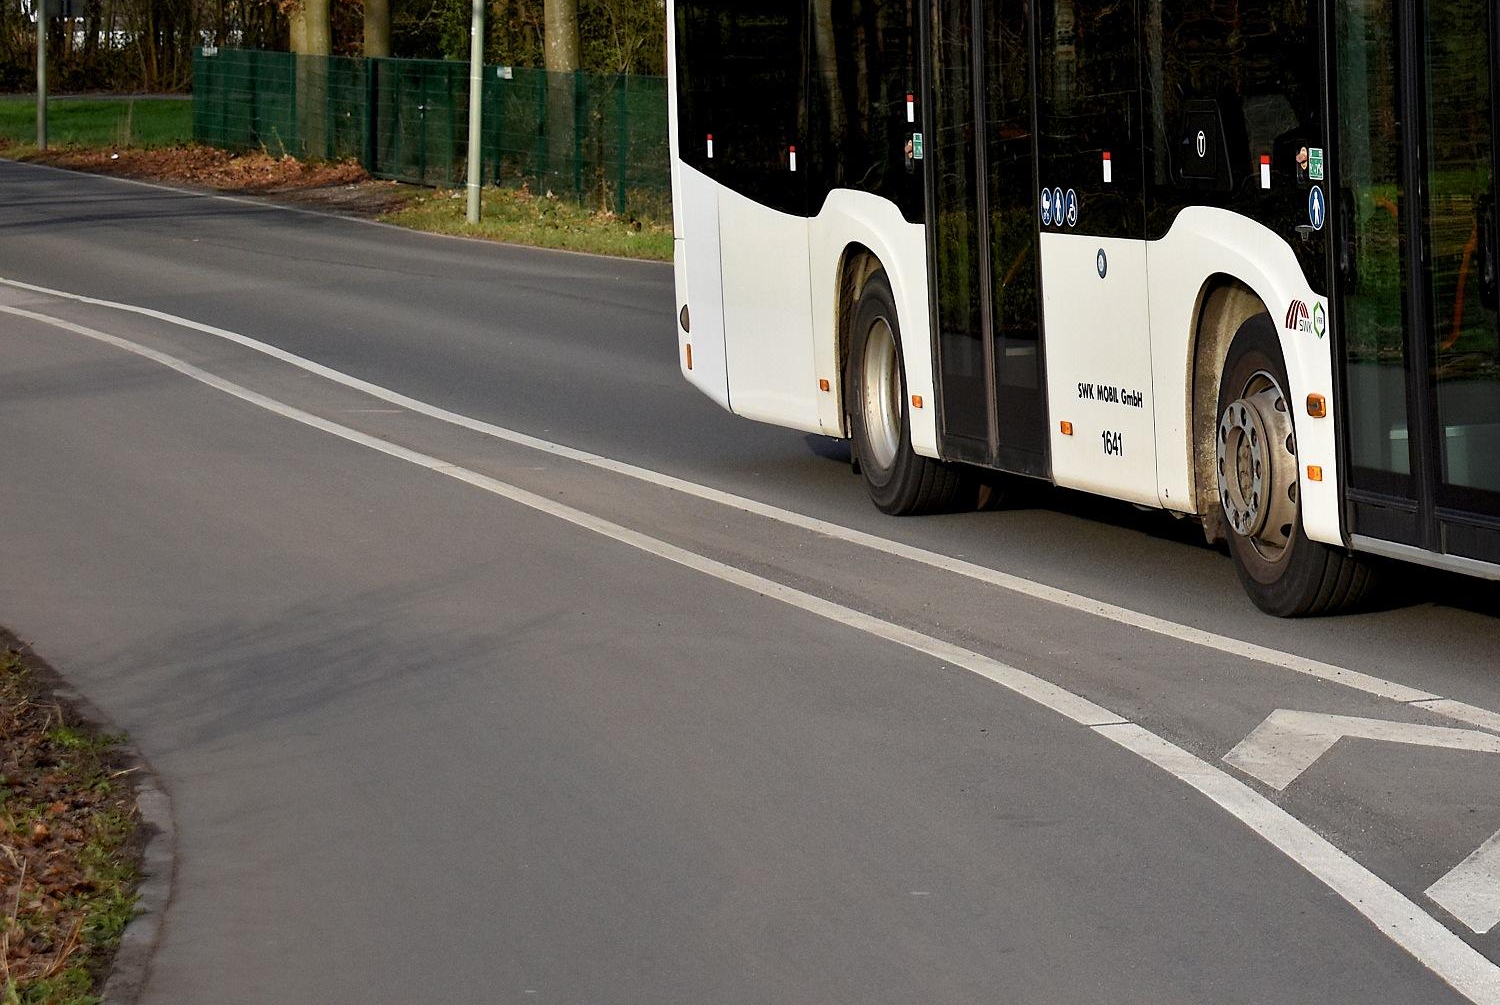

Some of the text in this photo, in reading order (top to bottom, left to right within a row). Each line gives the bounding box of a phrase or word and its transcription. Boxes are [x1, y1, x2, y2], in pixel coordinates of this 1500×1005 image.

[1299, 319, 1313, 334] SWK
[1078, 382, 1143, 408] SWK MOBIL GmbH
[1102, 430, 1123, 457] 1641
